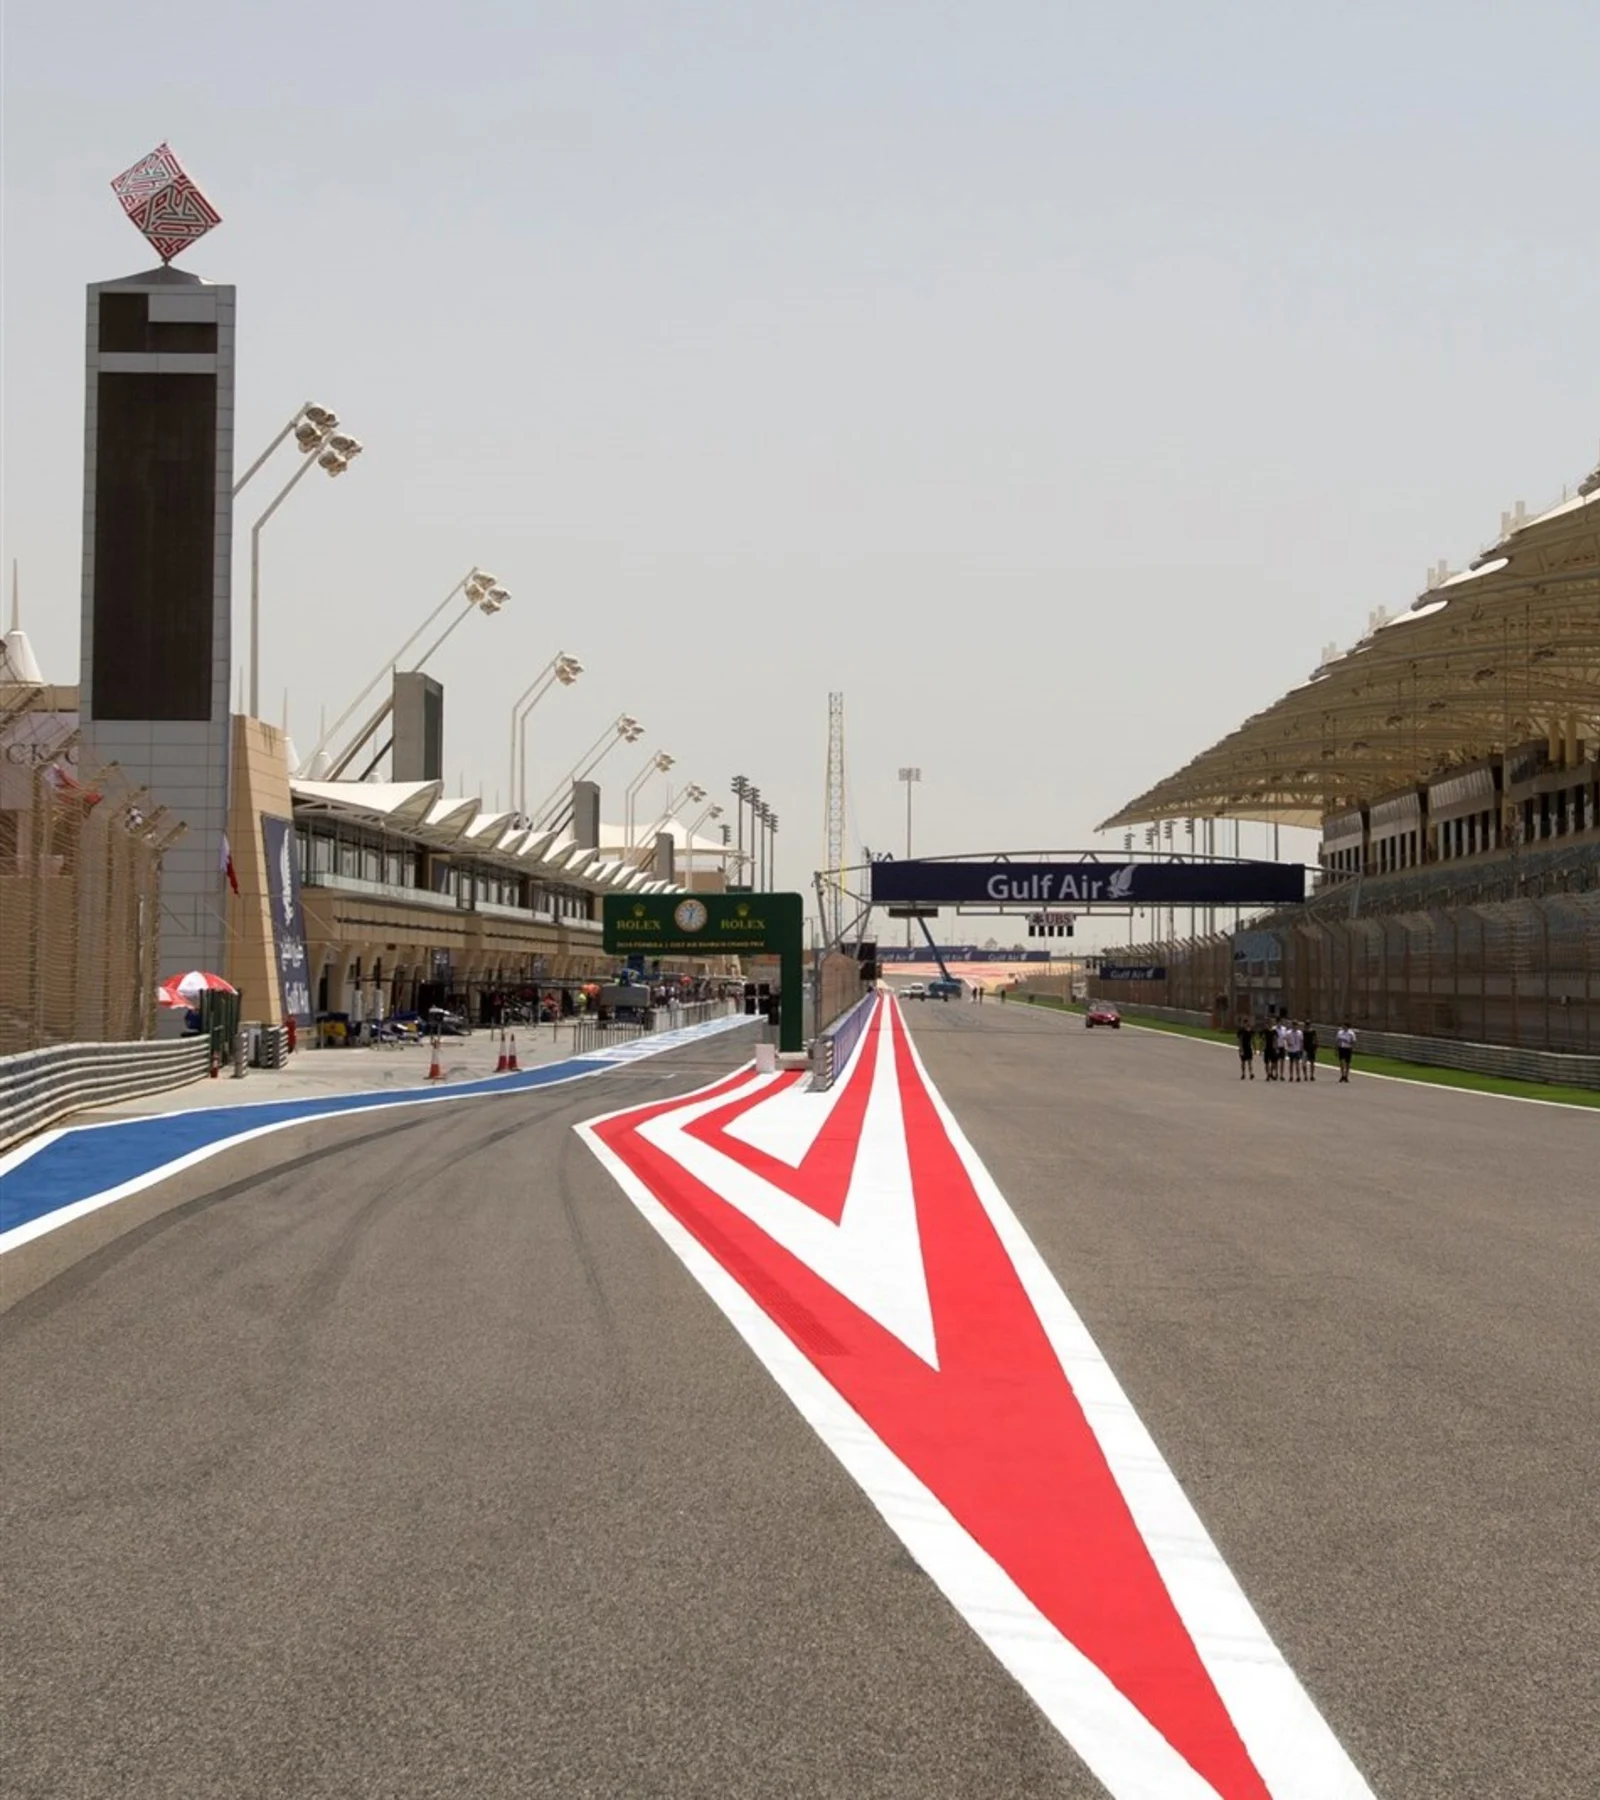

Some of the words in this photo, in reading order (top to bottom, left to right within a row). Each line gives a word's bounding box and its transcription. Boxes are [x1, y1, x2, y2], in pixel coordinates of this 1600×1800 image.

[986, 873, 1054, 899] Gulf
[1058, 873, 1103, 899] Air
[721, 919, 766, 930] ROLEX
[1046, 912, 1071, 925] UBS
[616, 920, 661, 930] ROLEX
